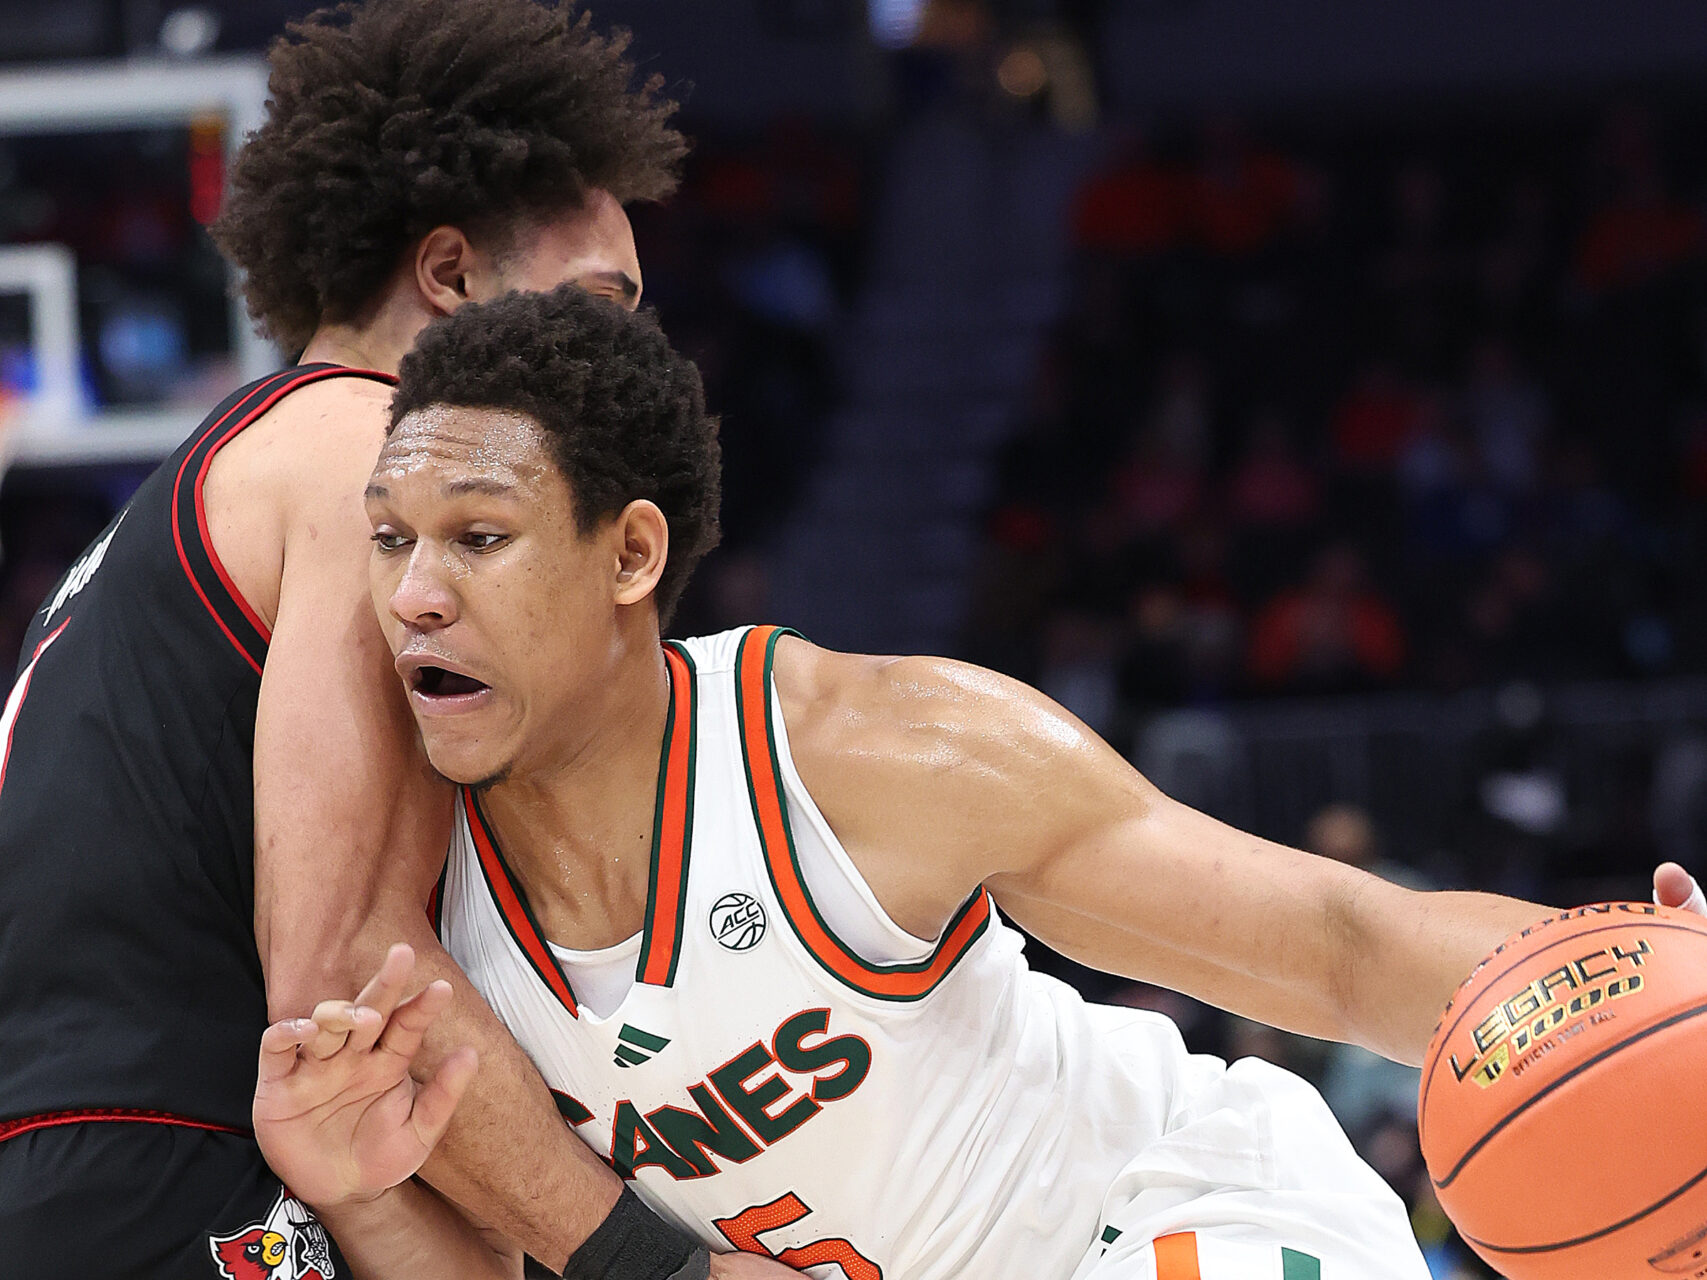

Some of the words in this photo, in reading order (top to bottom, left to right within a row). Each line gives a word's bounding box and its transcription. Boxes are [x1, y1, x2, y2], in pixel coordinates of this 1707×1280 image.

[719, 899, 759, 935] ACC
[1447, 938, 1654, 1083] LEGACY
[1511, 974, 1645, 1055] 1000
[1512, 1039, 1556, 1076] OFFICIAL
